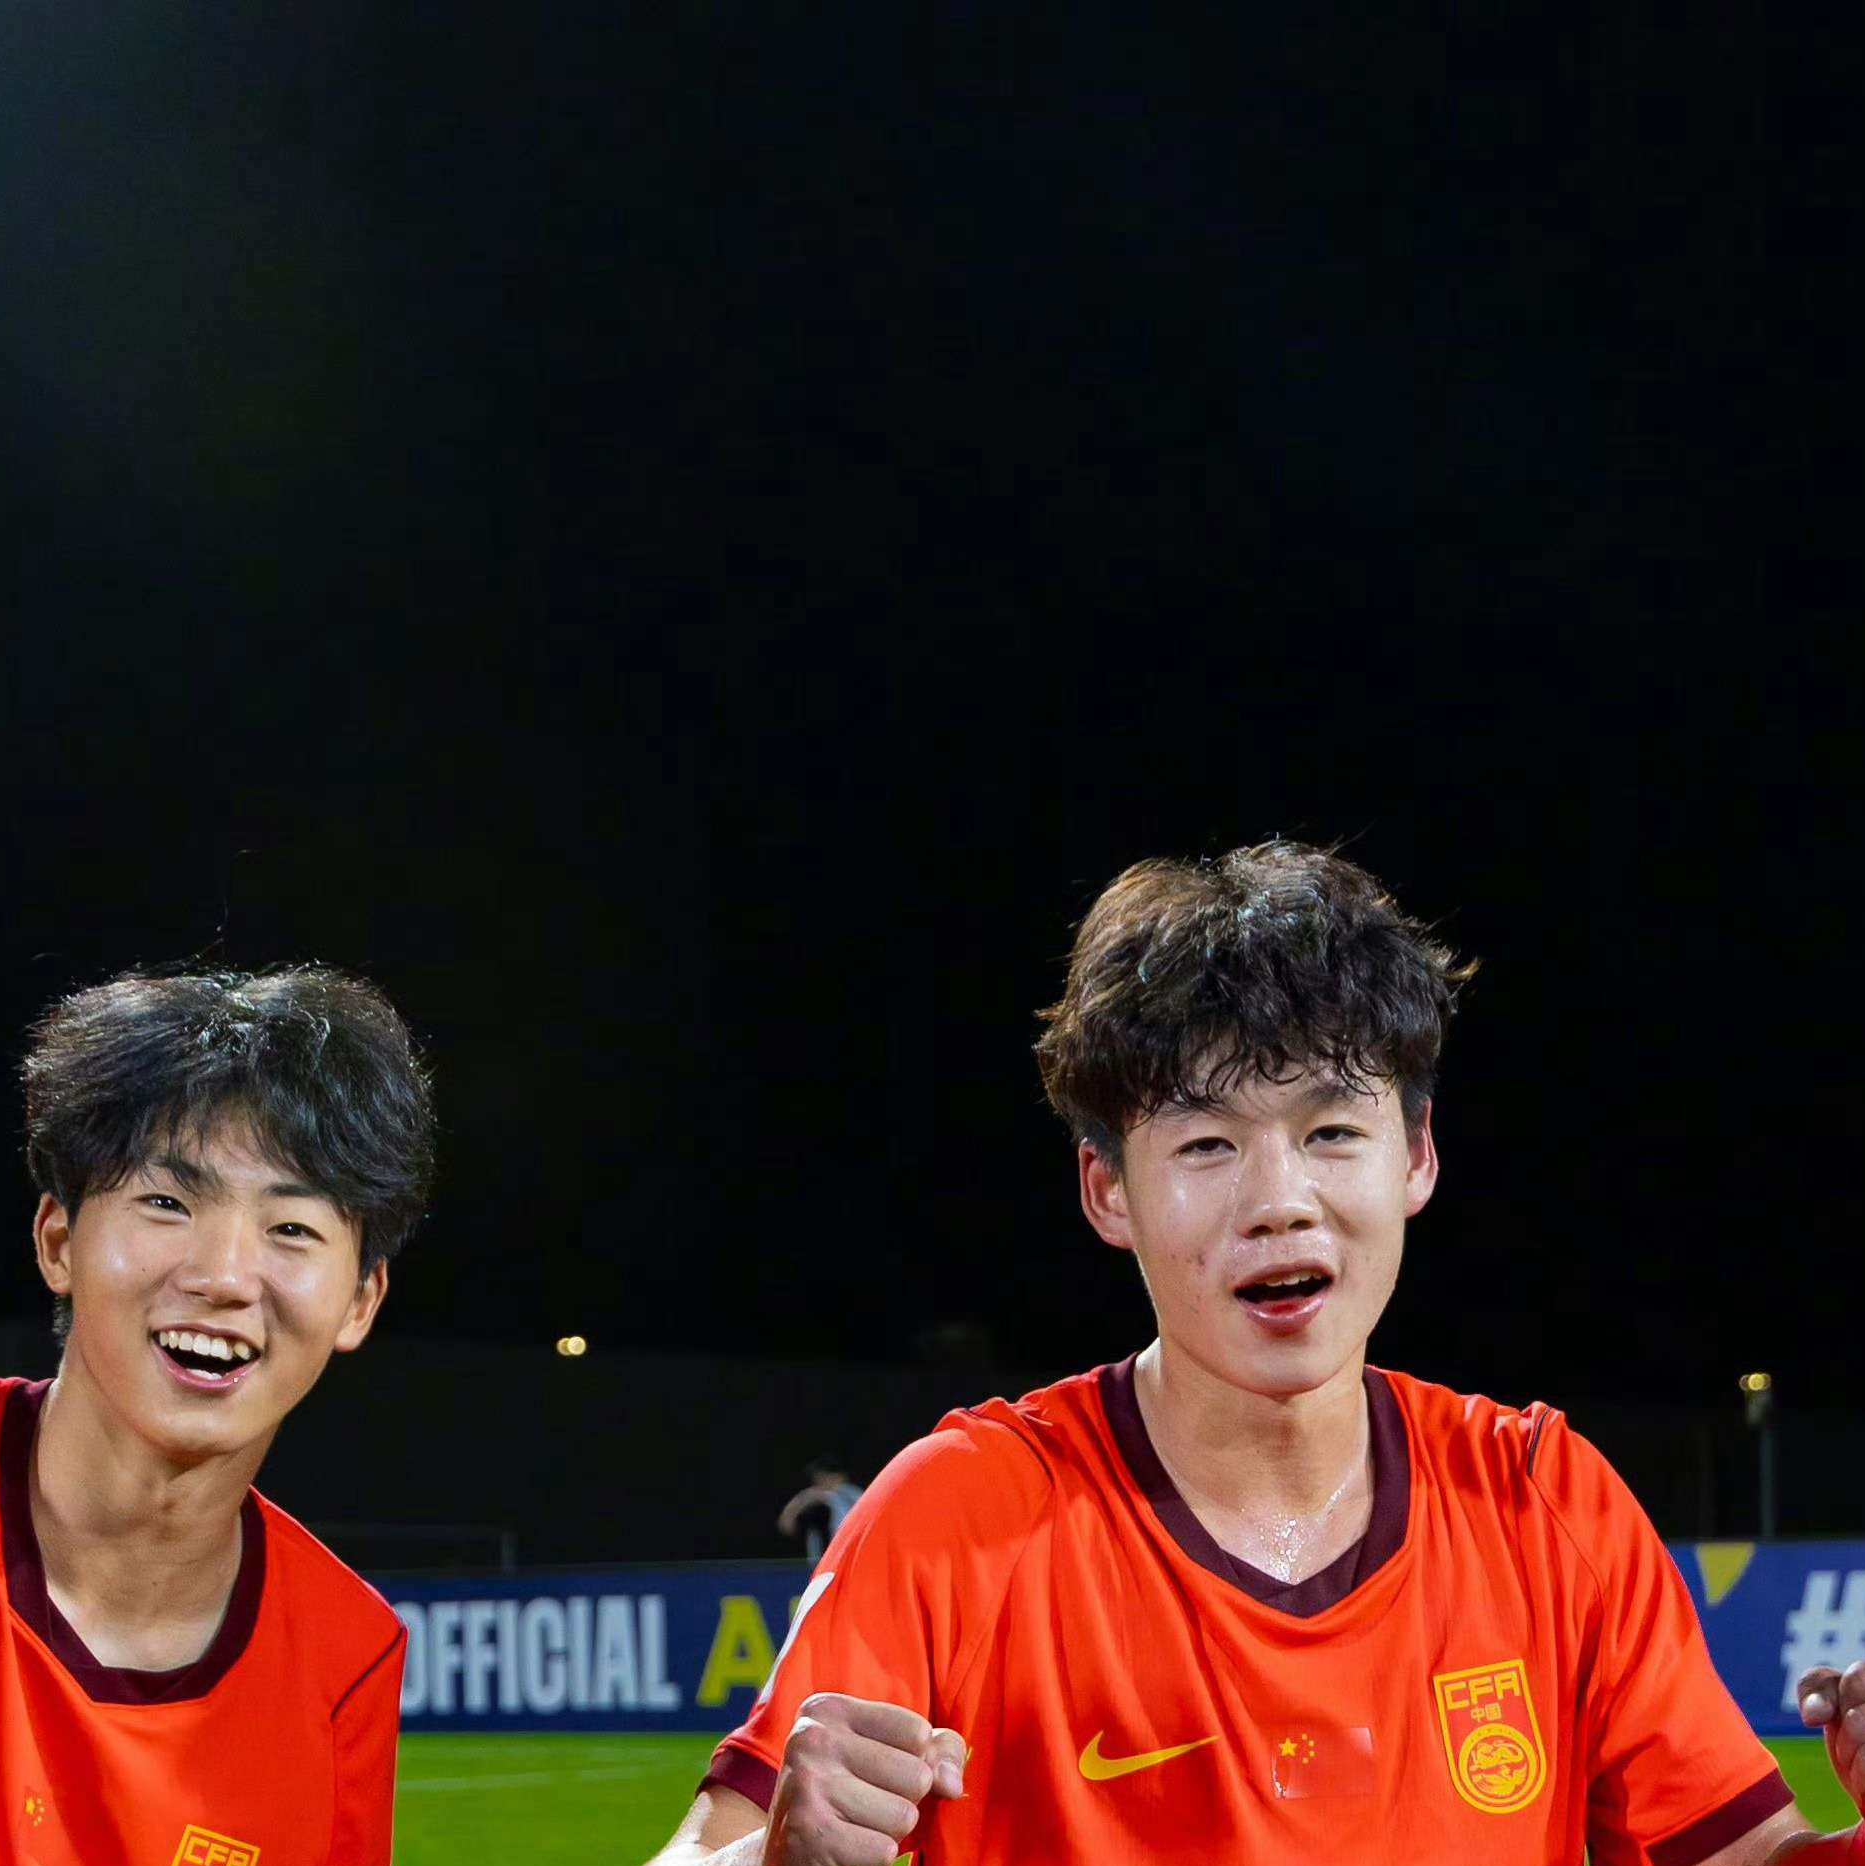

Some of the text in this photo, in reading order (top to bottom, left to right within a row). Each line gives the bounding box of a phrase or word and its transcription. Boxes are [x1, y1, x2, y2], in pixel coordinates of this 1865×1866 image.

[696, 1595, 801, 1708] A
[1443, 1671, 1521, 1710] CFA
[1470, 1702, 1502, 1723] 中国
